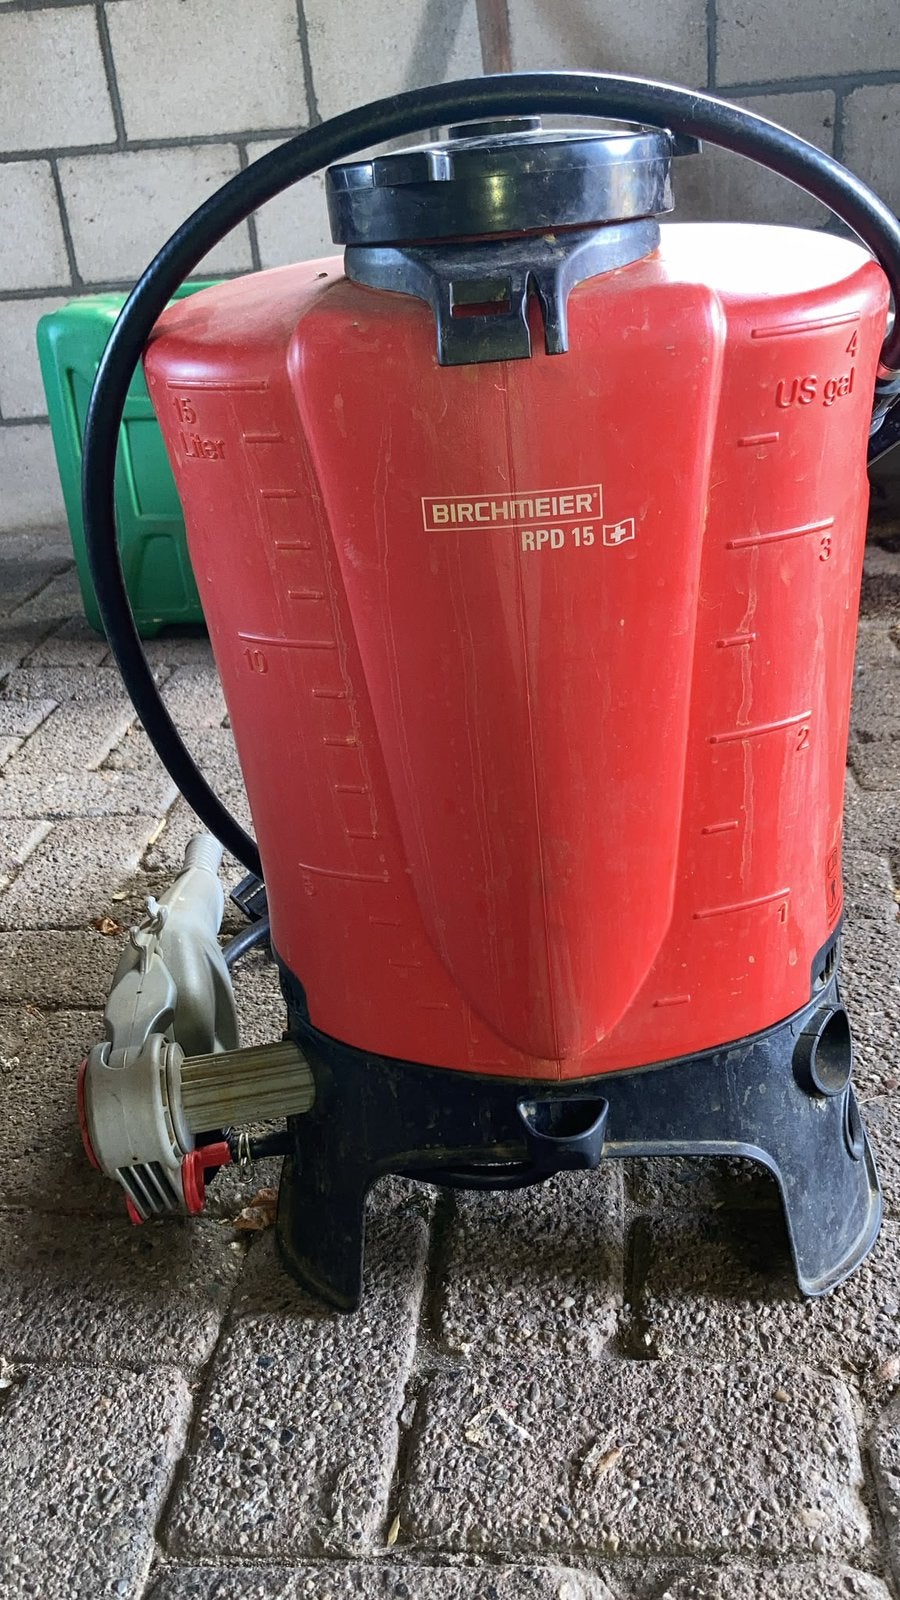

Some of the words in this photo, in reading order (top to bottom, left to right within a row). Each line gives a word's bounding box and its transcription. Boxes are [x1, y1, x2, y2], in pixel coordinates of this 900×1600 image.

[845, 329, 857, 358] 4
[775, 374, 817, 408] US
[823, 366, 855, 407] gal
[173, 396, 196, 425] 15
[179, 431, 226, 461] Liter
[432, 493, 593, 524] BIRCHMEIER
[521, 528, 565, 551] RPD
[571, 526, 595, 547] 15
[819, 532, 831, 561] 3
[243, 647, 269, 675] 10
[796, 725, 810, 751] 2
[777, 900, 788, 924] 1
